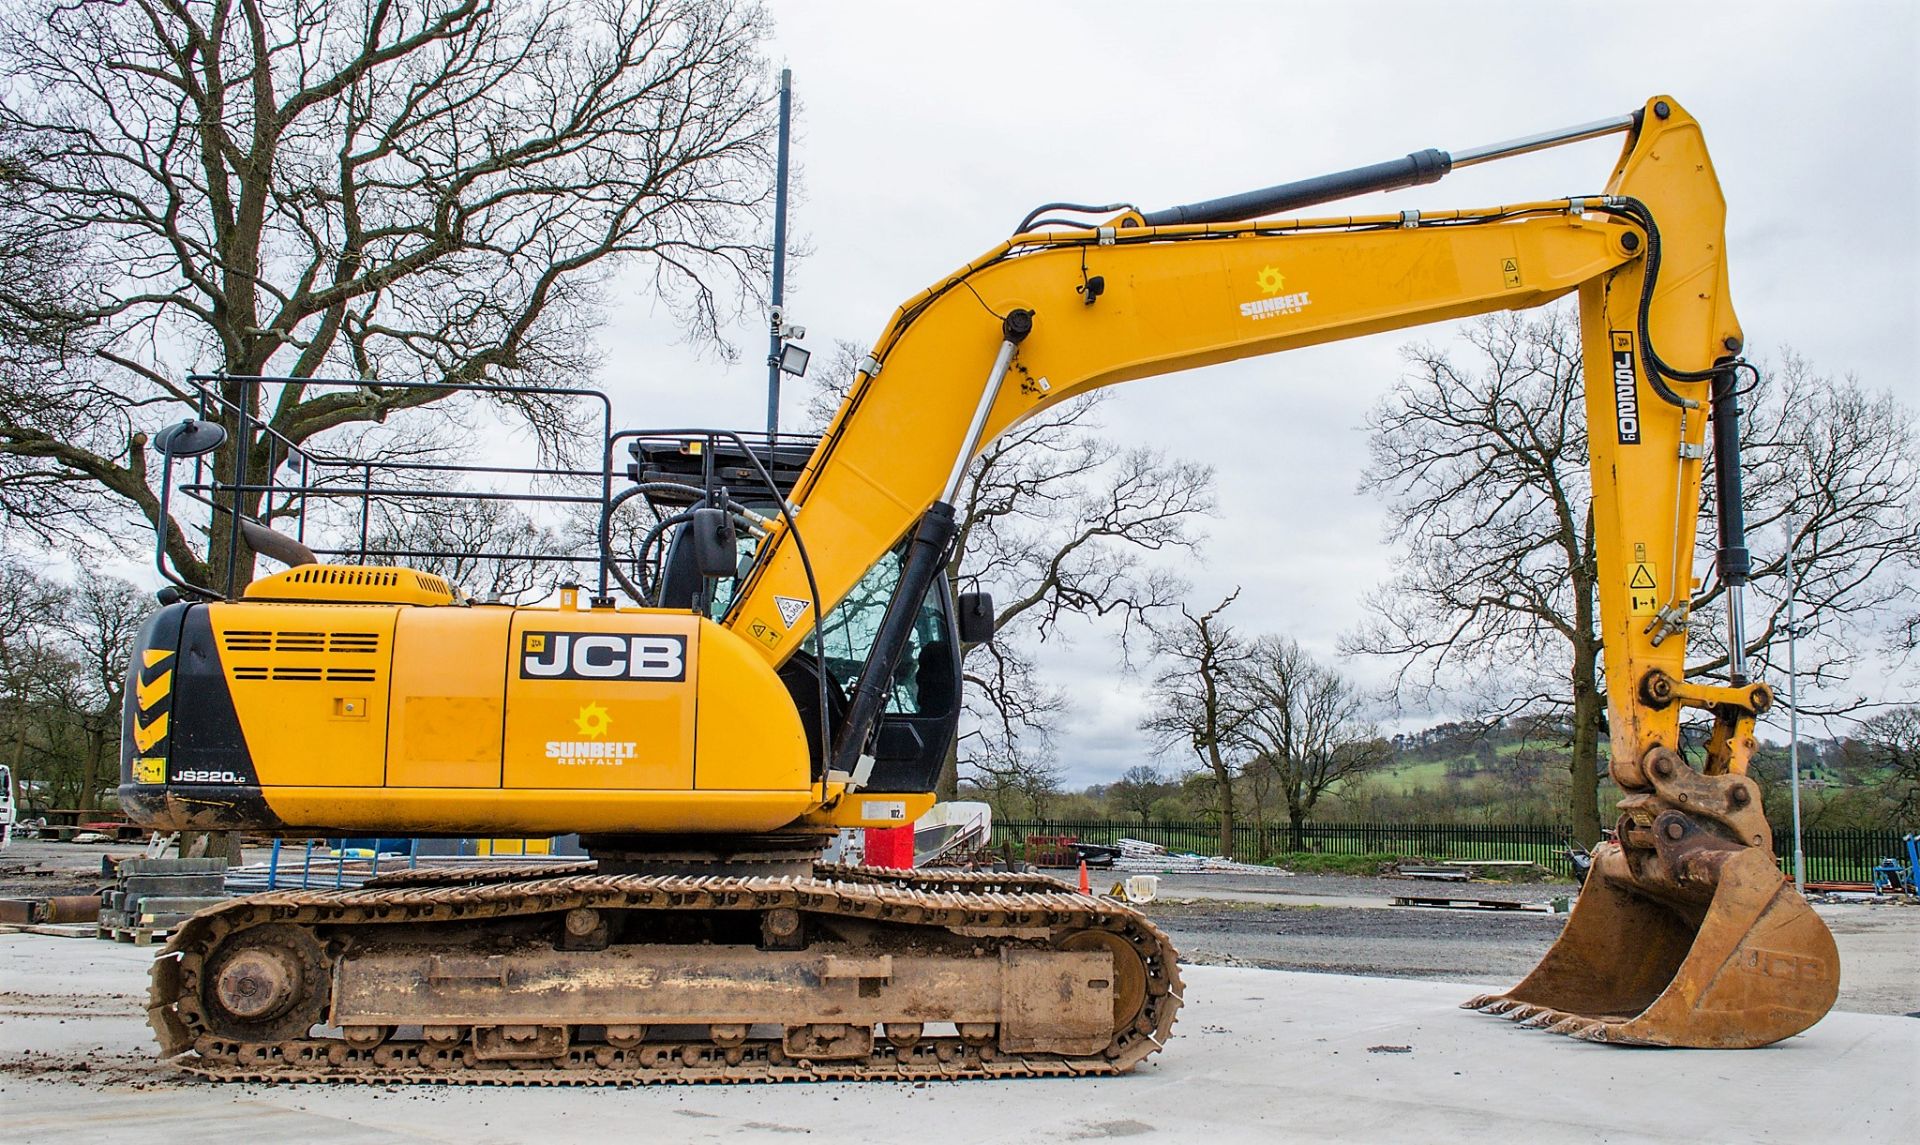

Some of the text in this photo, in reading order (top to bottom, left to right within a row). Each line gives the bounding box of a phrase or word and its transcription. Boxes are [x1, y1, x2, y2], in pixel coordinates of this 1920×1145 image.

[1240, 291, 1310, 317] SUNBELT
[1252, 306, 1302, 321] RENTALS
[525, 635, 683, 678] JCB
[545, 741, 637, 759] SUNBELT
[557, 758, 623, 766] RENTALS
